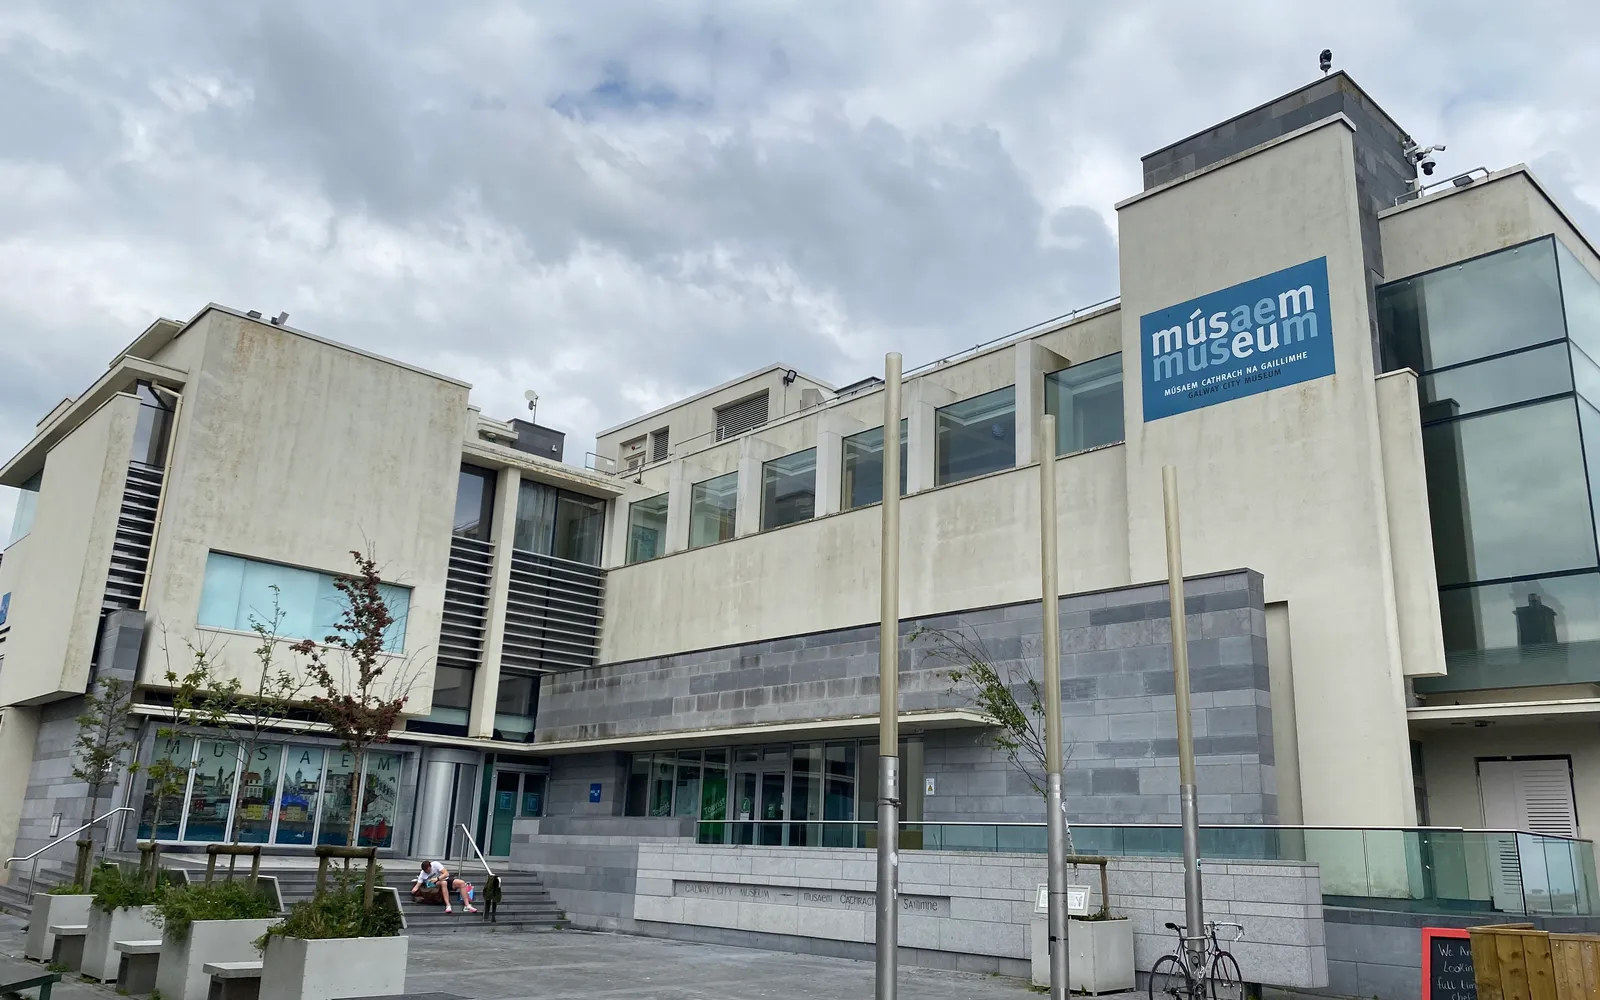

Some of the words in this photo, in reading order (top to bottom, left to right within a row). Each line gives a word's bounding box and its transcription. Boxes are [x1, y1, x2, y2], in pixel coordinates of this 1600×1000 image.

[1152, 285, 1314, 355] músaem
[1153, 311, 1318, 382] museum
[1164, 381, 1198, 397] MÚSAEM
[1201, 369, 1243, 386] CATHRACH
[1246, 365, 1258, 374] NA
[1261, 351, 1308, 370] GAILLIMHE
[1188, 385, 1219, 399] GALWAY
[1223, 378, 1240, 390] CITY
[1244, 369, 1282, 384] MUSEUM
[717, 887, 733, 895] CITY
[740, 888, 770, 898] MUSEUM
[1438, 944, 1454, 957] We
[1443, 961, 1474, 973] Lookin
